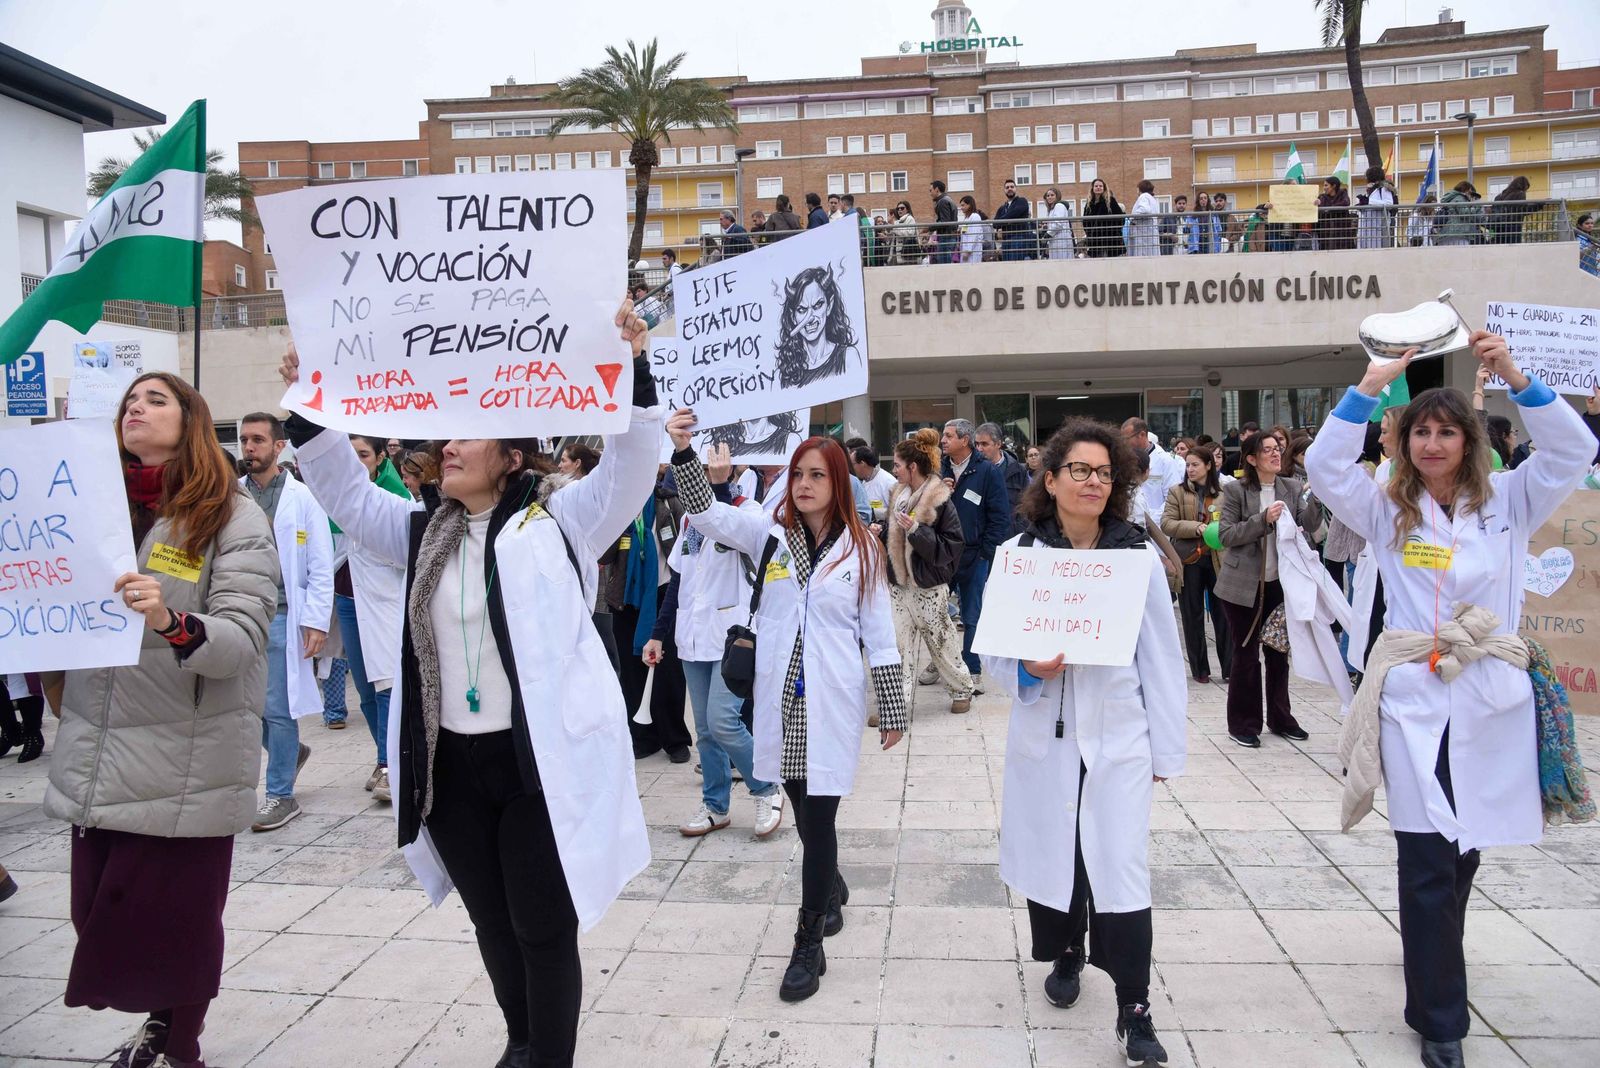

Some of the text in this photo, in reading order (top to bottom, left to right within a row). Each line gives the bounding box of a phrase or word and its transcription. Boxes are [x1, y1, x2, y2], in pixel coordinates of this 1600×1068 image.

[920, 36, 1024, 53] HOSPITAL
[310, 193, 594, 240] CON TALENTO
[340, 243, 532, 286] Y VOCACIÓN
[692, 270, 737, 307] ESTE
[881, 270, 1382, 315] CENTRO DE DOCUMENTACIÓN CLÍNICA
[331, 287, 551, 328] NO SE PAGA
[1488, 304, 1504, 318] NO
[1523, 307, 1565, 324] GUARDIAS
[683, 302, 763, 341] ESTATUTO
[1486, 322, 1502, 337] NO
[402, 313, 569, 358] PENSIÓN
[653, 347, 678, 365] SO
[692, 334, 762, 366] LEEMOS
[356, 369, 415, 391] HORA
[494, 361, 567, 383] HORA
[341, 391, 439, 416] TRABAJADA
[48, 460, 77, 498] A
[0, 513, 74, 551] CIAR
[151, 552, 170, 562] ESTOY
[1052, 559, 1112, 578] MÉDICOS
[1032, 589, 1086, 605] NO HAY
[1023, 617, 1102, 640] SANIDAD!
